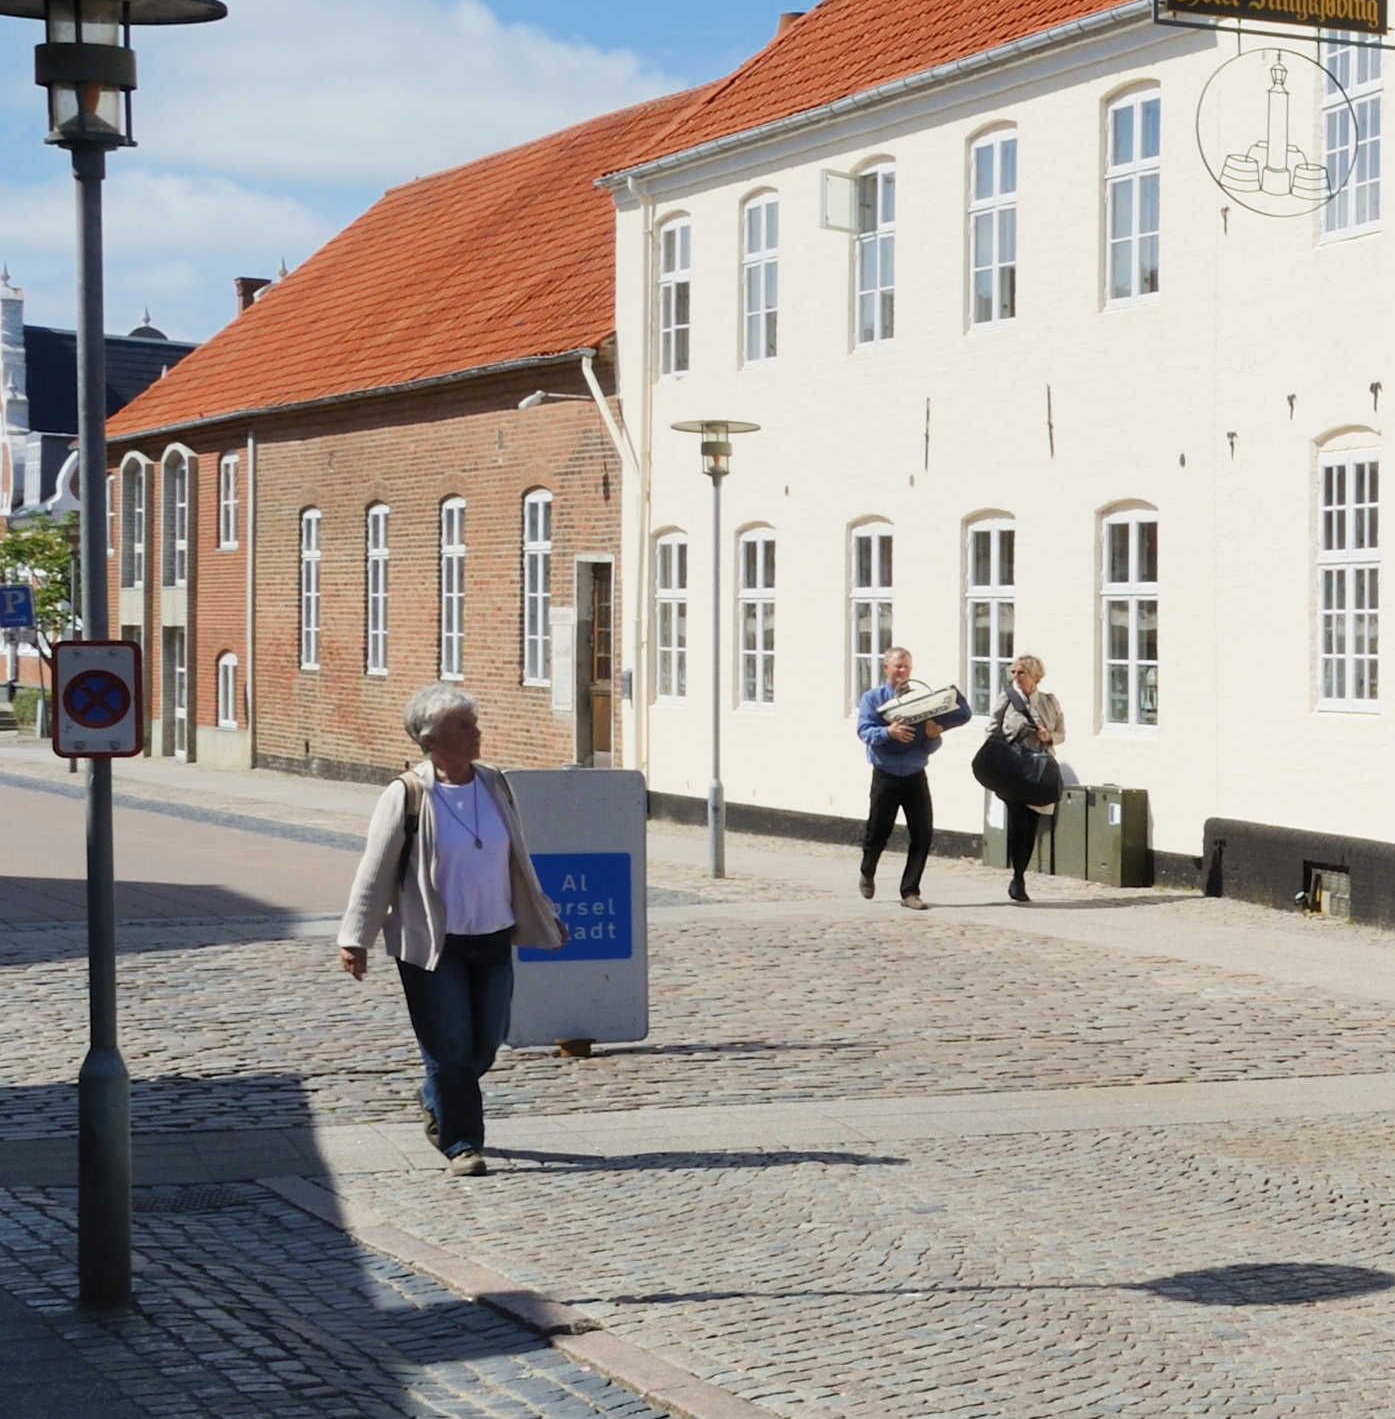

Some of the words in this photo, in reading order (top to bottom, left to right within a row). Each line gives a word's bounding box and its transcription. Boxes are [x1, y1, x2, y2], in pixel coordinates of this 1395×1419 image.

[3, 591, 25, 613] P
[561, 874, 588, 892] Al
[552, 898, 616, 916] ørsel
